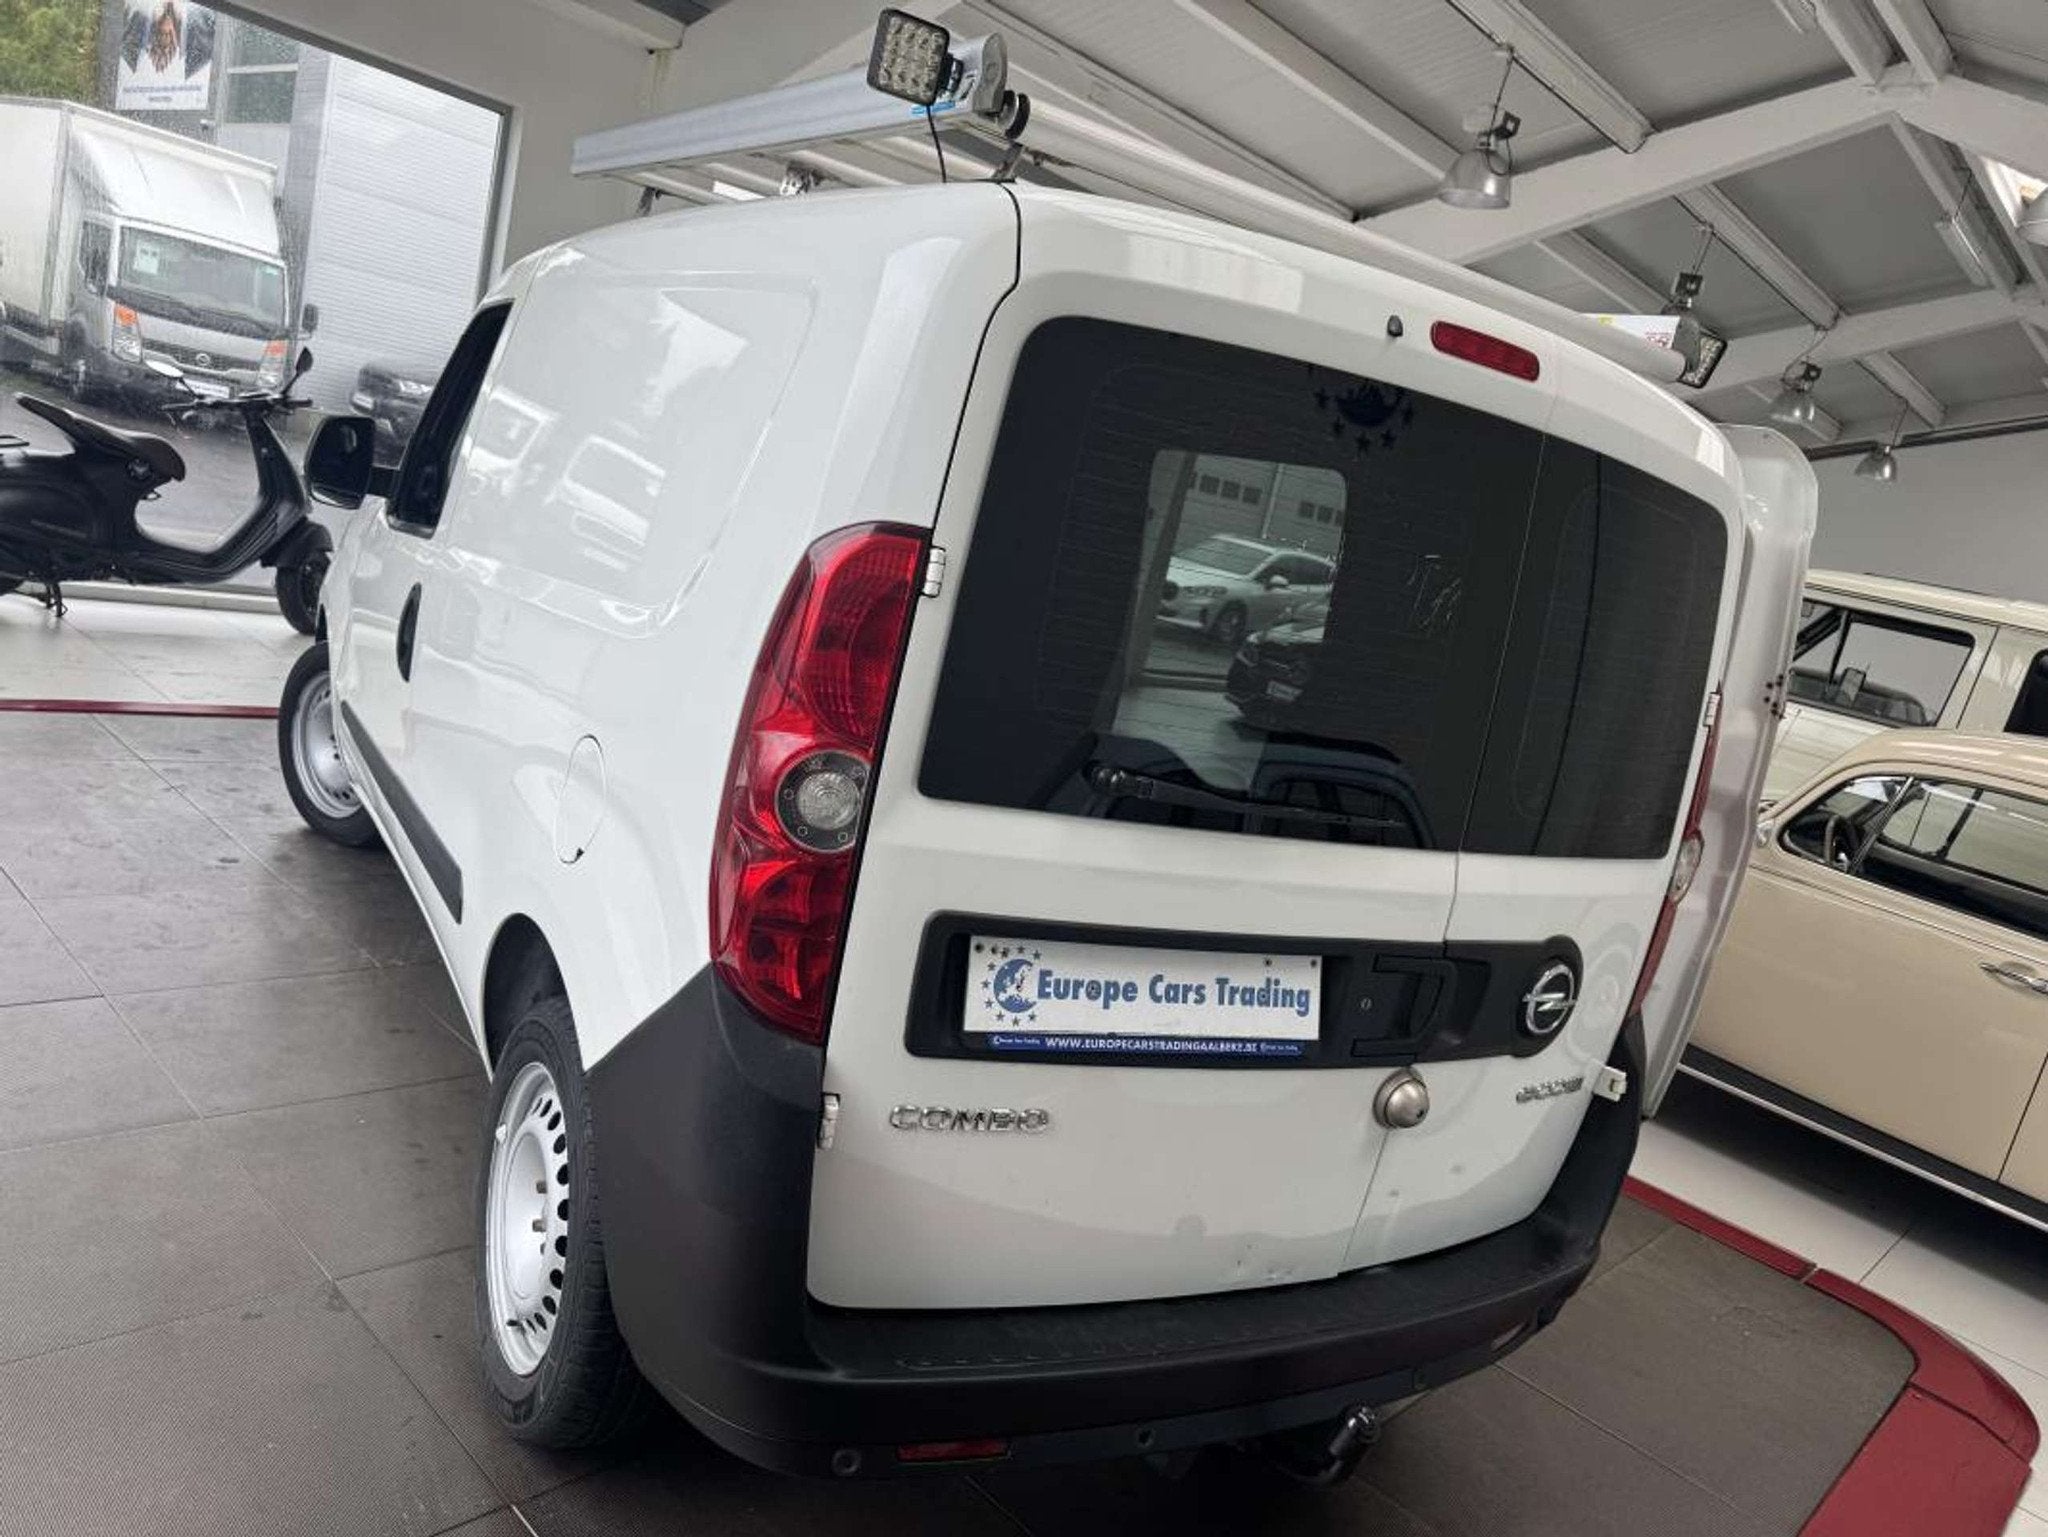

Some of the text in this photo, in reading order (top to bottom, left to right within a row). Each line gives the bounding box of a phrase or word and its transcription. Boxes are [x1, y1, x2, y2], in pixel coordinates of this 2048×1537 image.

[1037, 969, 1311, 1017] Europe Cars Trading
[889, 1104, 1049, 1134] COMBO
